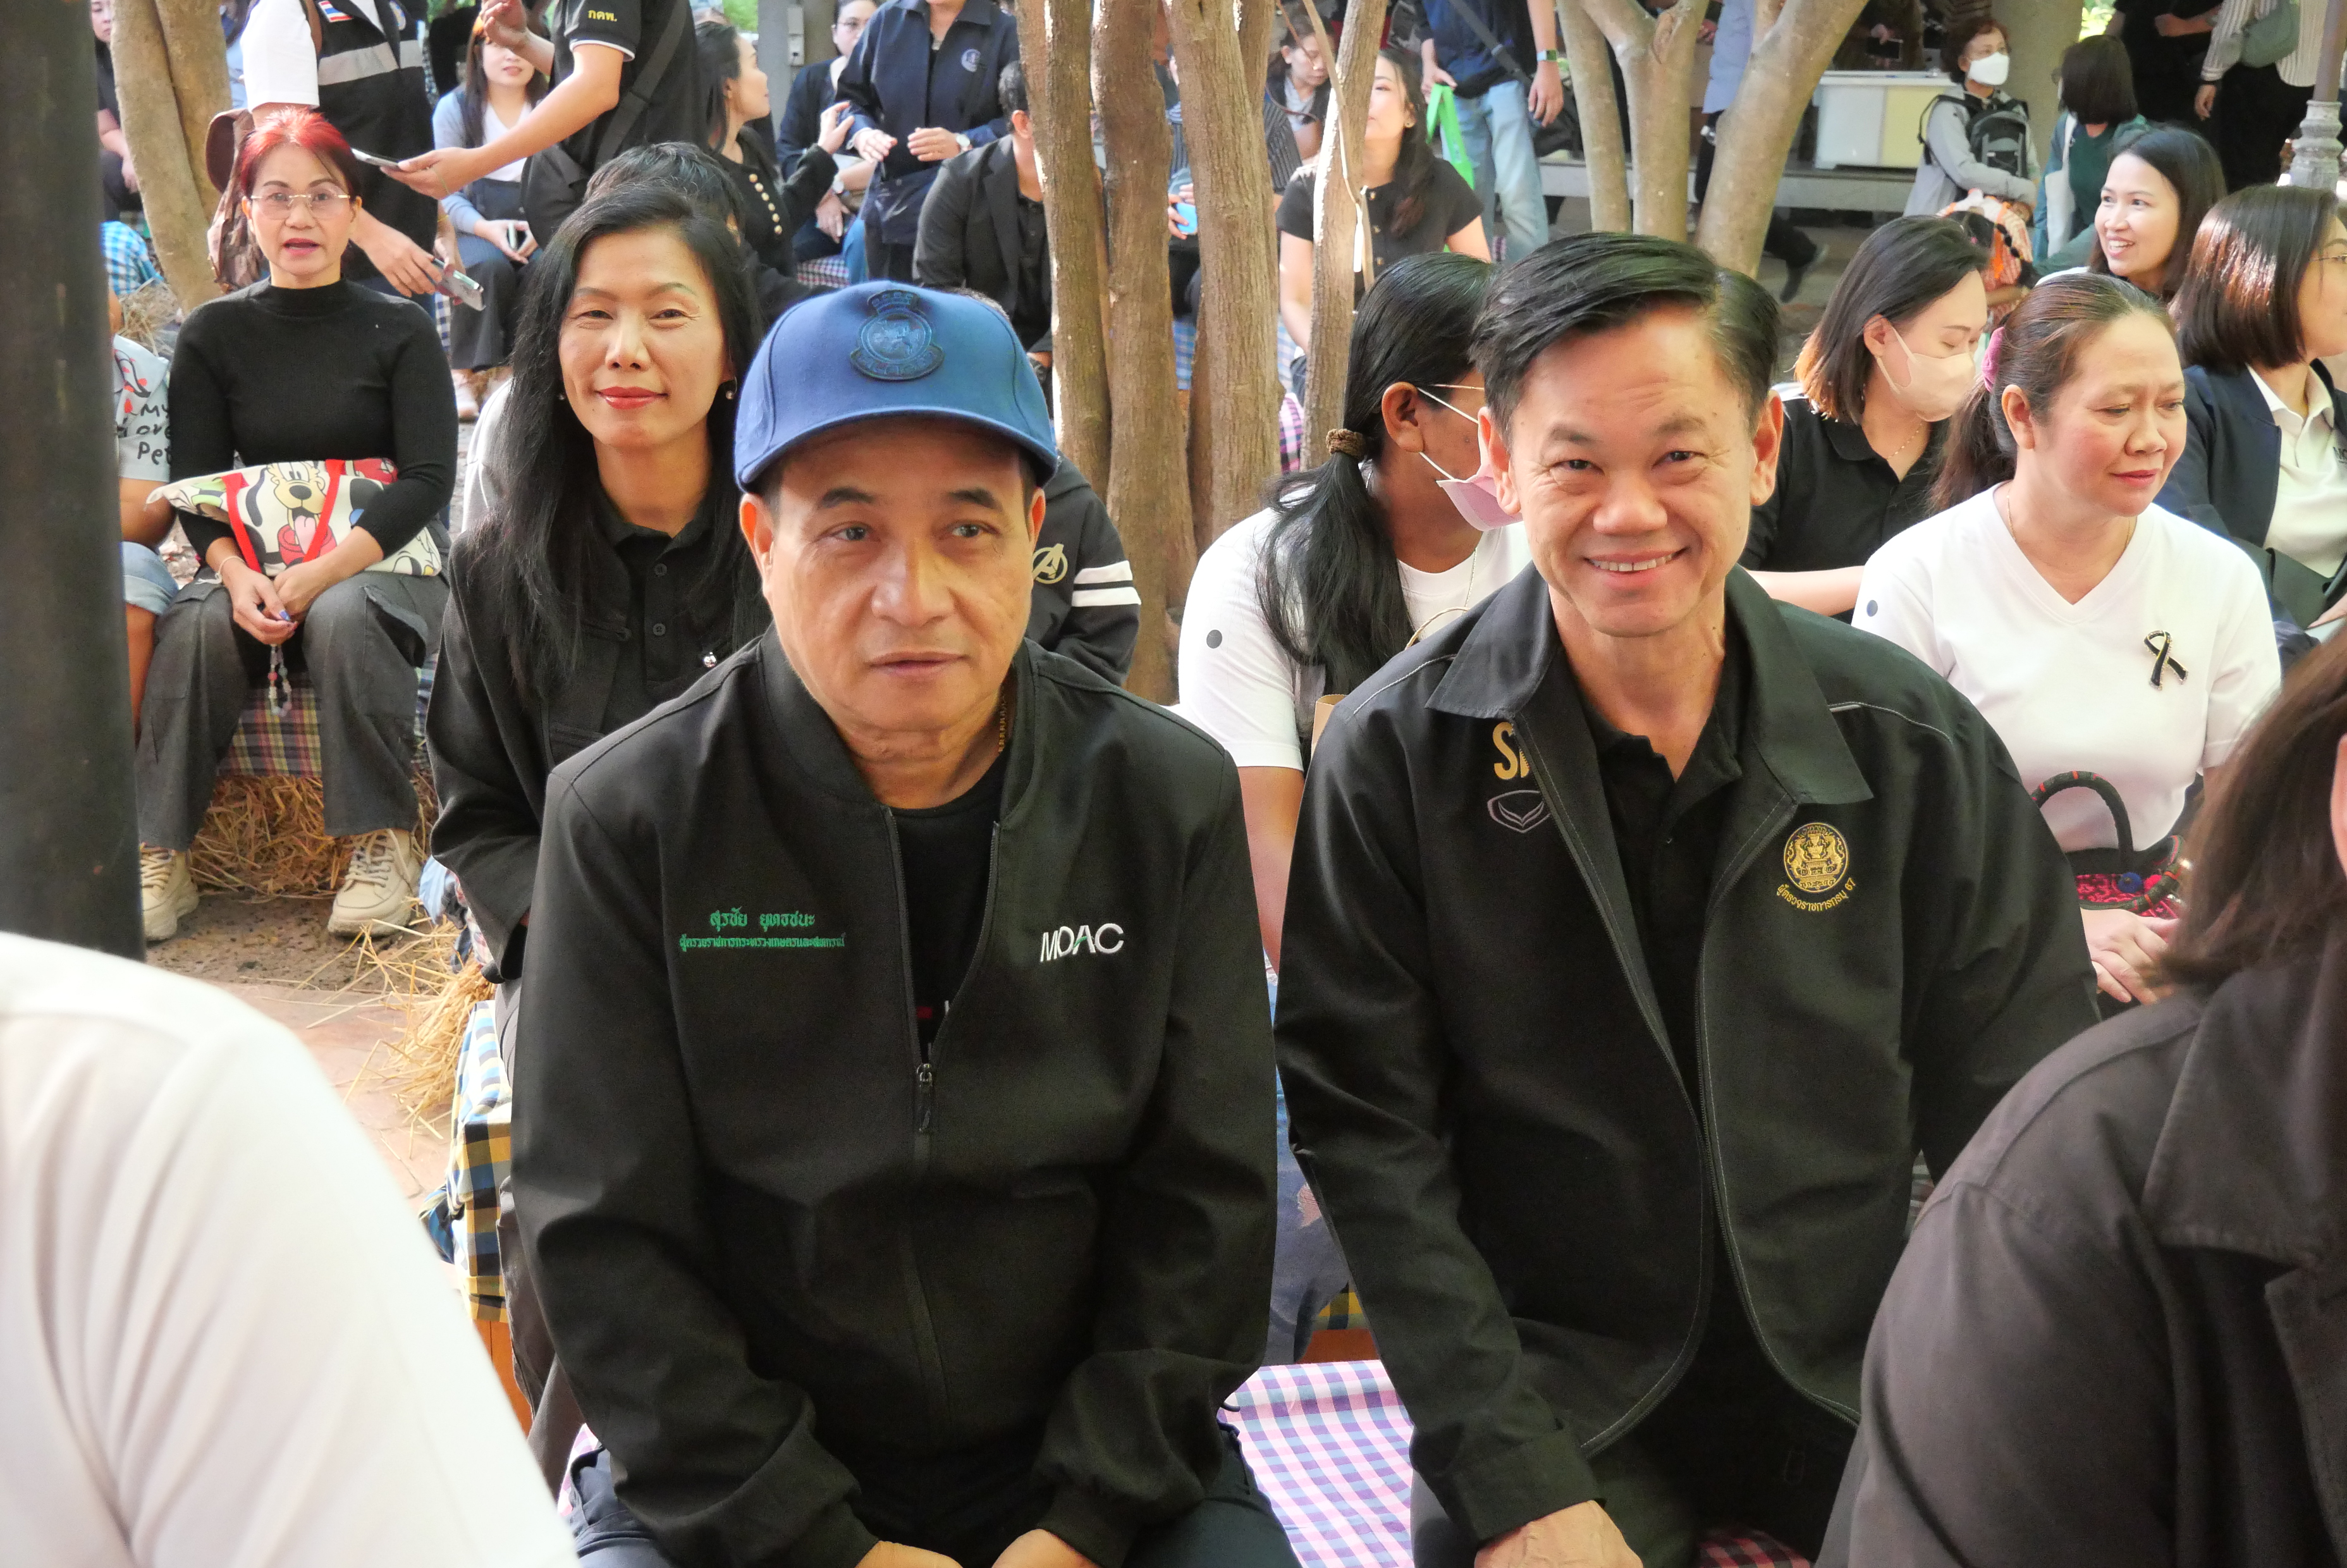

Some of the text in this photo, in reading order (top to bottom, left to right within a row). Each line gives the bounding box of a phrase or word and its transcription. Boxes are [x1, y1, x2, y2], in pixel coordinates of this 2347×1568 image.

[1844, 877, 1856, 891] 67
[709, 906, 748, 932] สุรชัย
[1040, 922, 1124, 962] MOAC
